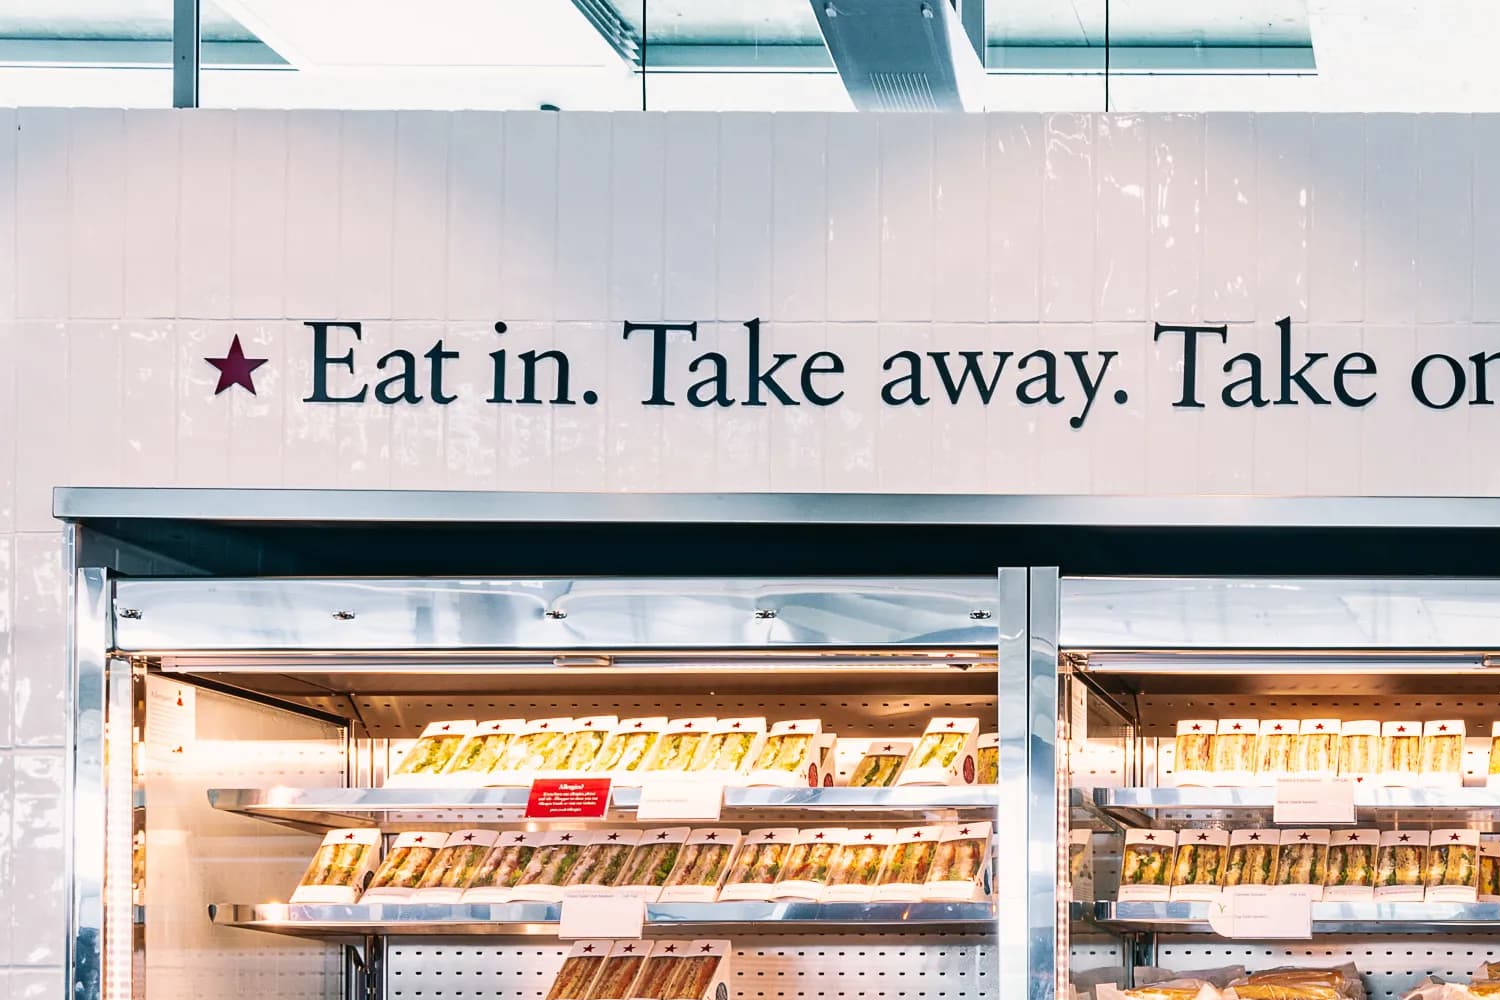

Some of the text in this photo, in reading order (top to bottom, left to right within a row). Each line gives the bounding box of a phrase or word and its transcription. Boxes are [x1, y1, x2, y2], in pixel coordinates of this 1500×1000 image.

[302, 321, 460, 405] Eat
[486, 321, 598, 405] in.
[622, 317, 845, 408] Take
[880, 349, 1128, 429] away.
[1153, 315, 1378, 408] Take
